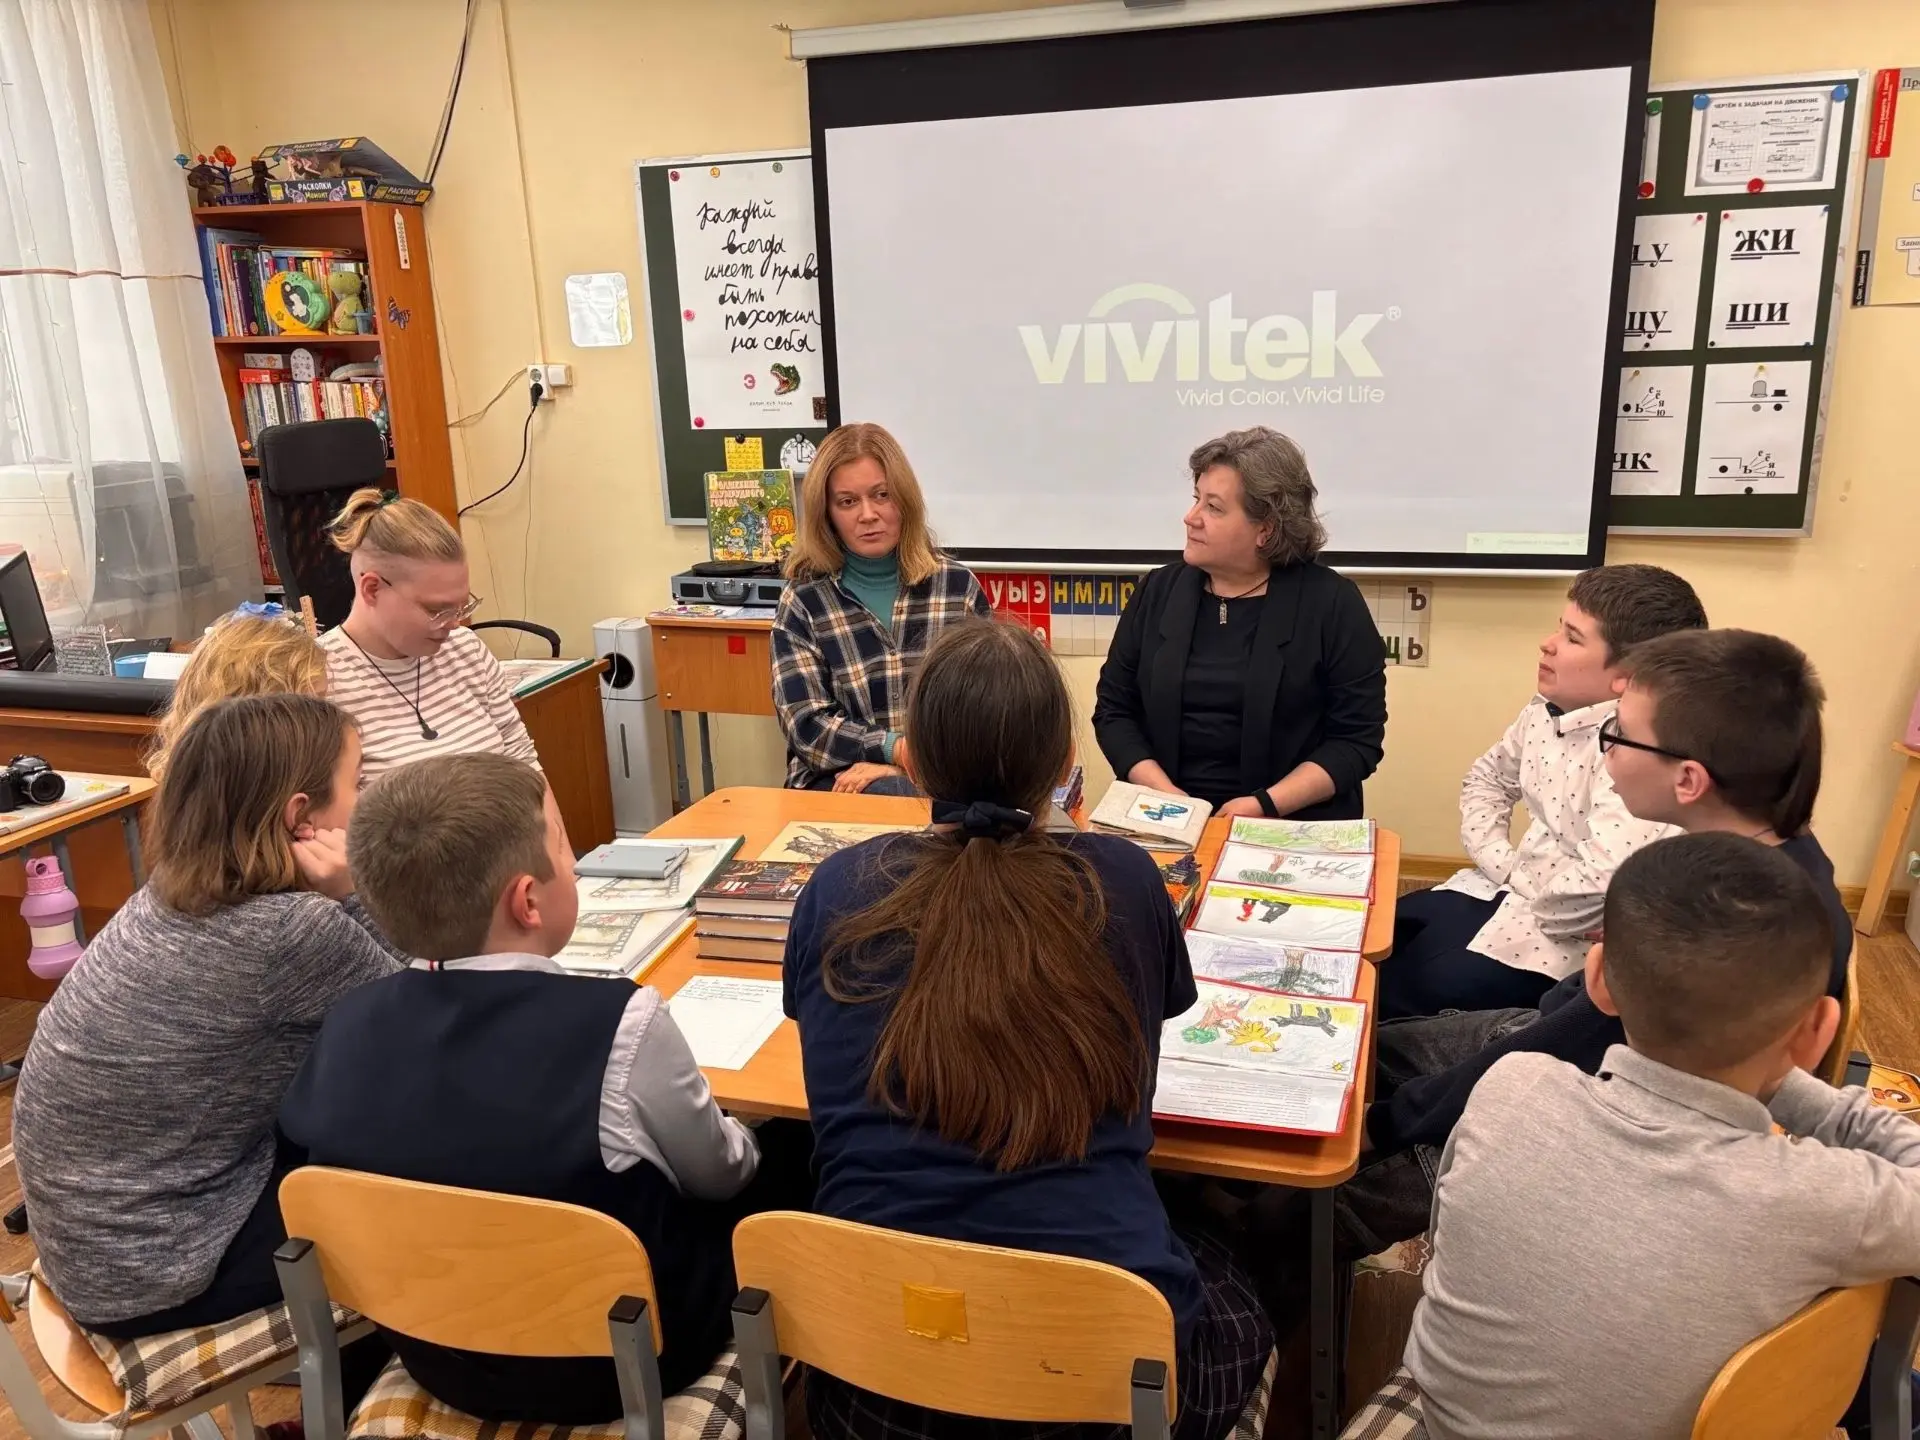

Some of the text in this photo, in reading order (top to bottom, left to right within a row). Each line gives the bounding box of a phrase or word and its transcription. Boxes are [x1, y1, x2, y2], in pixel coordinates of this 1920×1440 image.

[1902, 77, 1920, 90] Пр
[1784, 97, 1819, 106] ДВИЖЕНИЕ
[297, 182, 332, 191] РАСКОПКИ
[721, 229, 786, 278] всегда
[705, 262, 754, 281] имеет
[719, 283, 764, 305] быть
[731, 329, 816, 353] на себя
[1017, 283, 1385, 384] vivitek
[1176, 388, 1223, 407] Vivid
[1292, 385, 1343, 405] Vivid
[1348, 384, 1385, 404] Life
